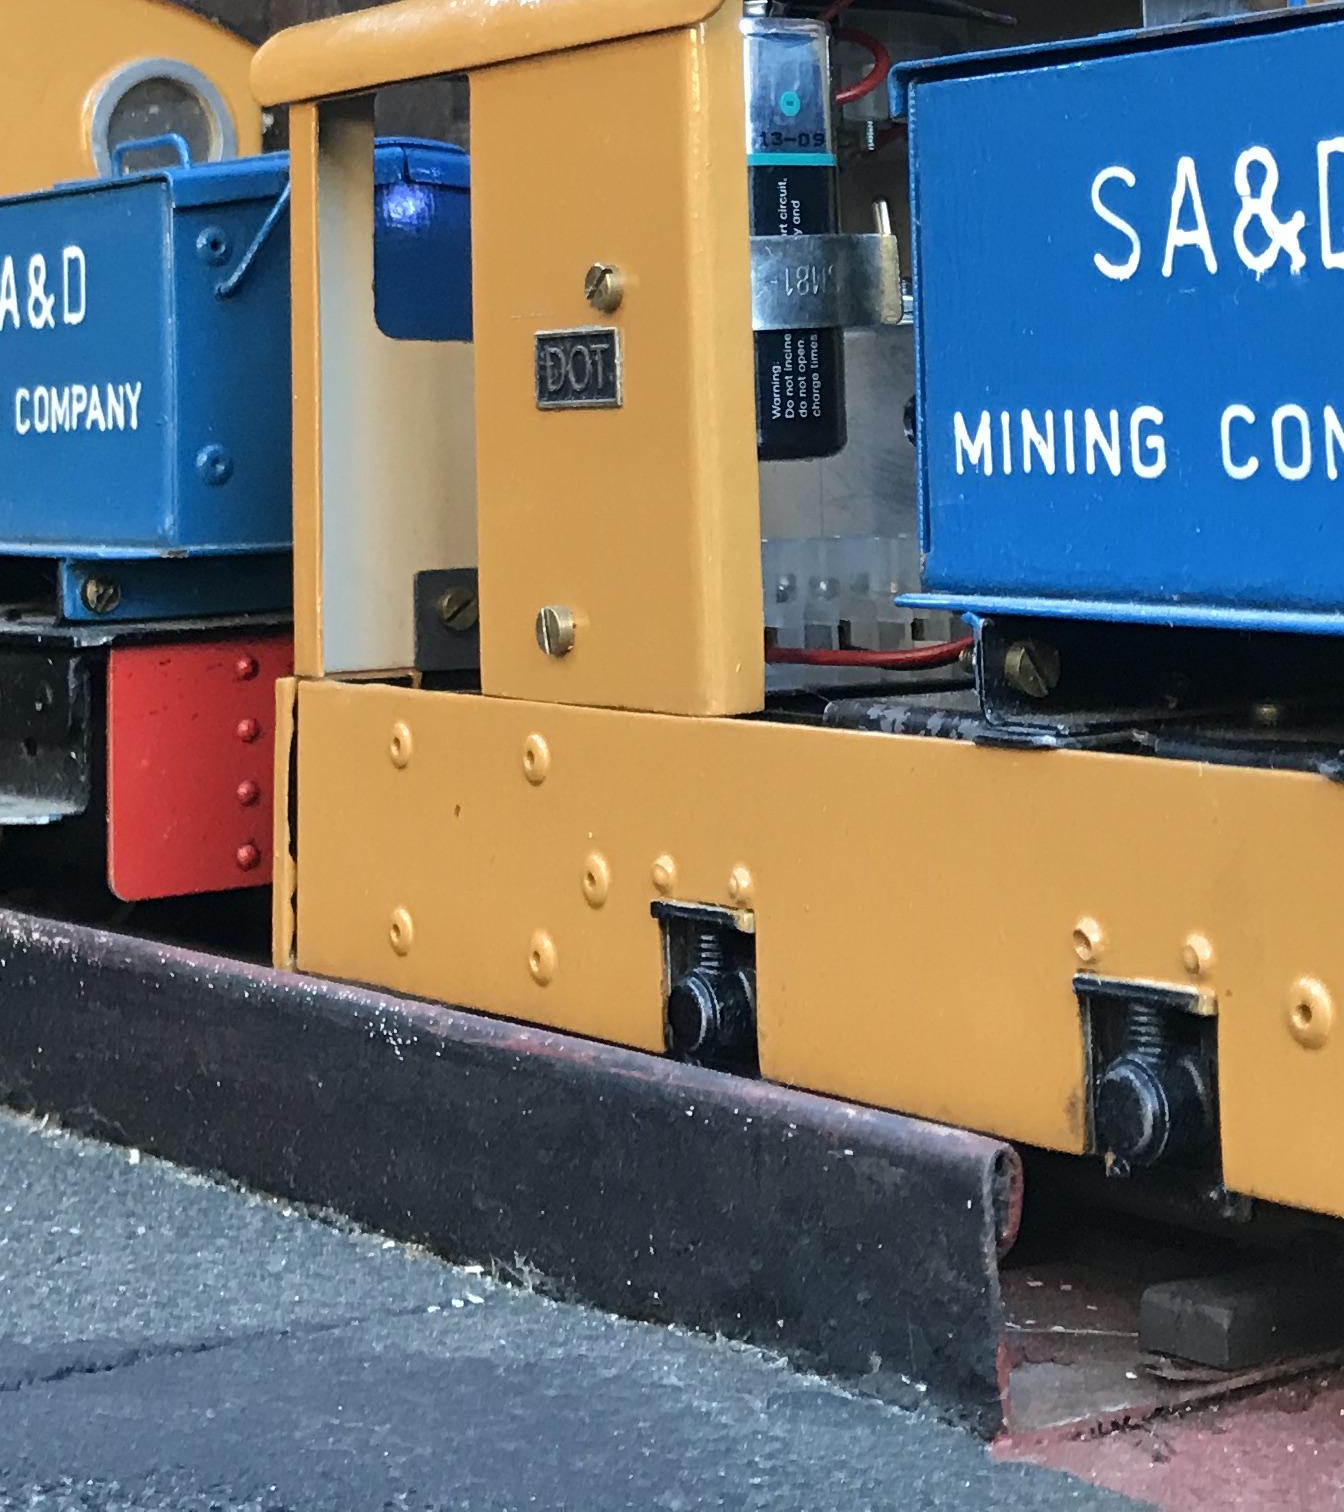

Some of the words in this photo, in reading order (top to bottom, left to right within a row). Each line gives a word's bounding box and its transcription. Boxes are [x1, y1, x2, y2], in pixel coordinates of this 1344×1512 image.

[791, 200, 801, 224] and
[542, 343, 610, 391] DOT
[784, 375, 794, 396] not
[797, 376, 807, 397] not
[811, 373, 822, 417] charge
[15, 381, 142, 435] COMPANY
[784, 400, 795, 419] Do
[797, 400, 808, 418] do
[953, 404, 1167, 480] MINING
